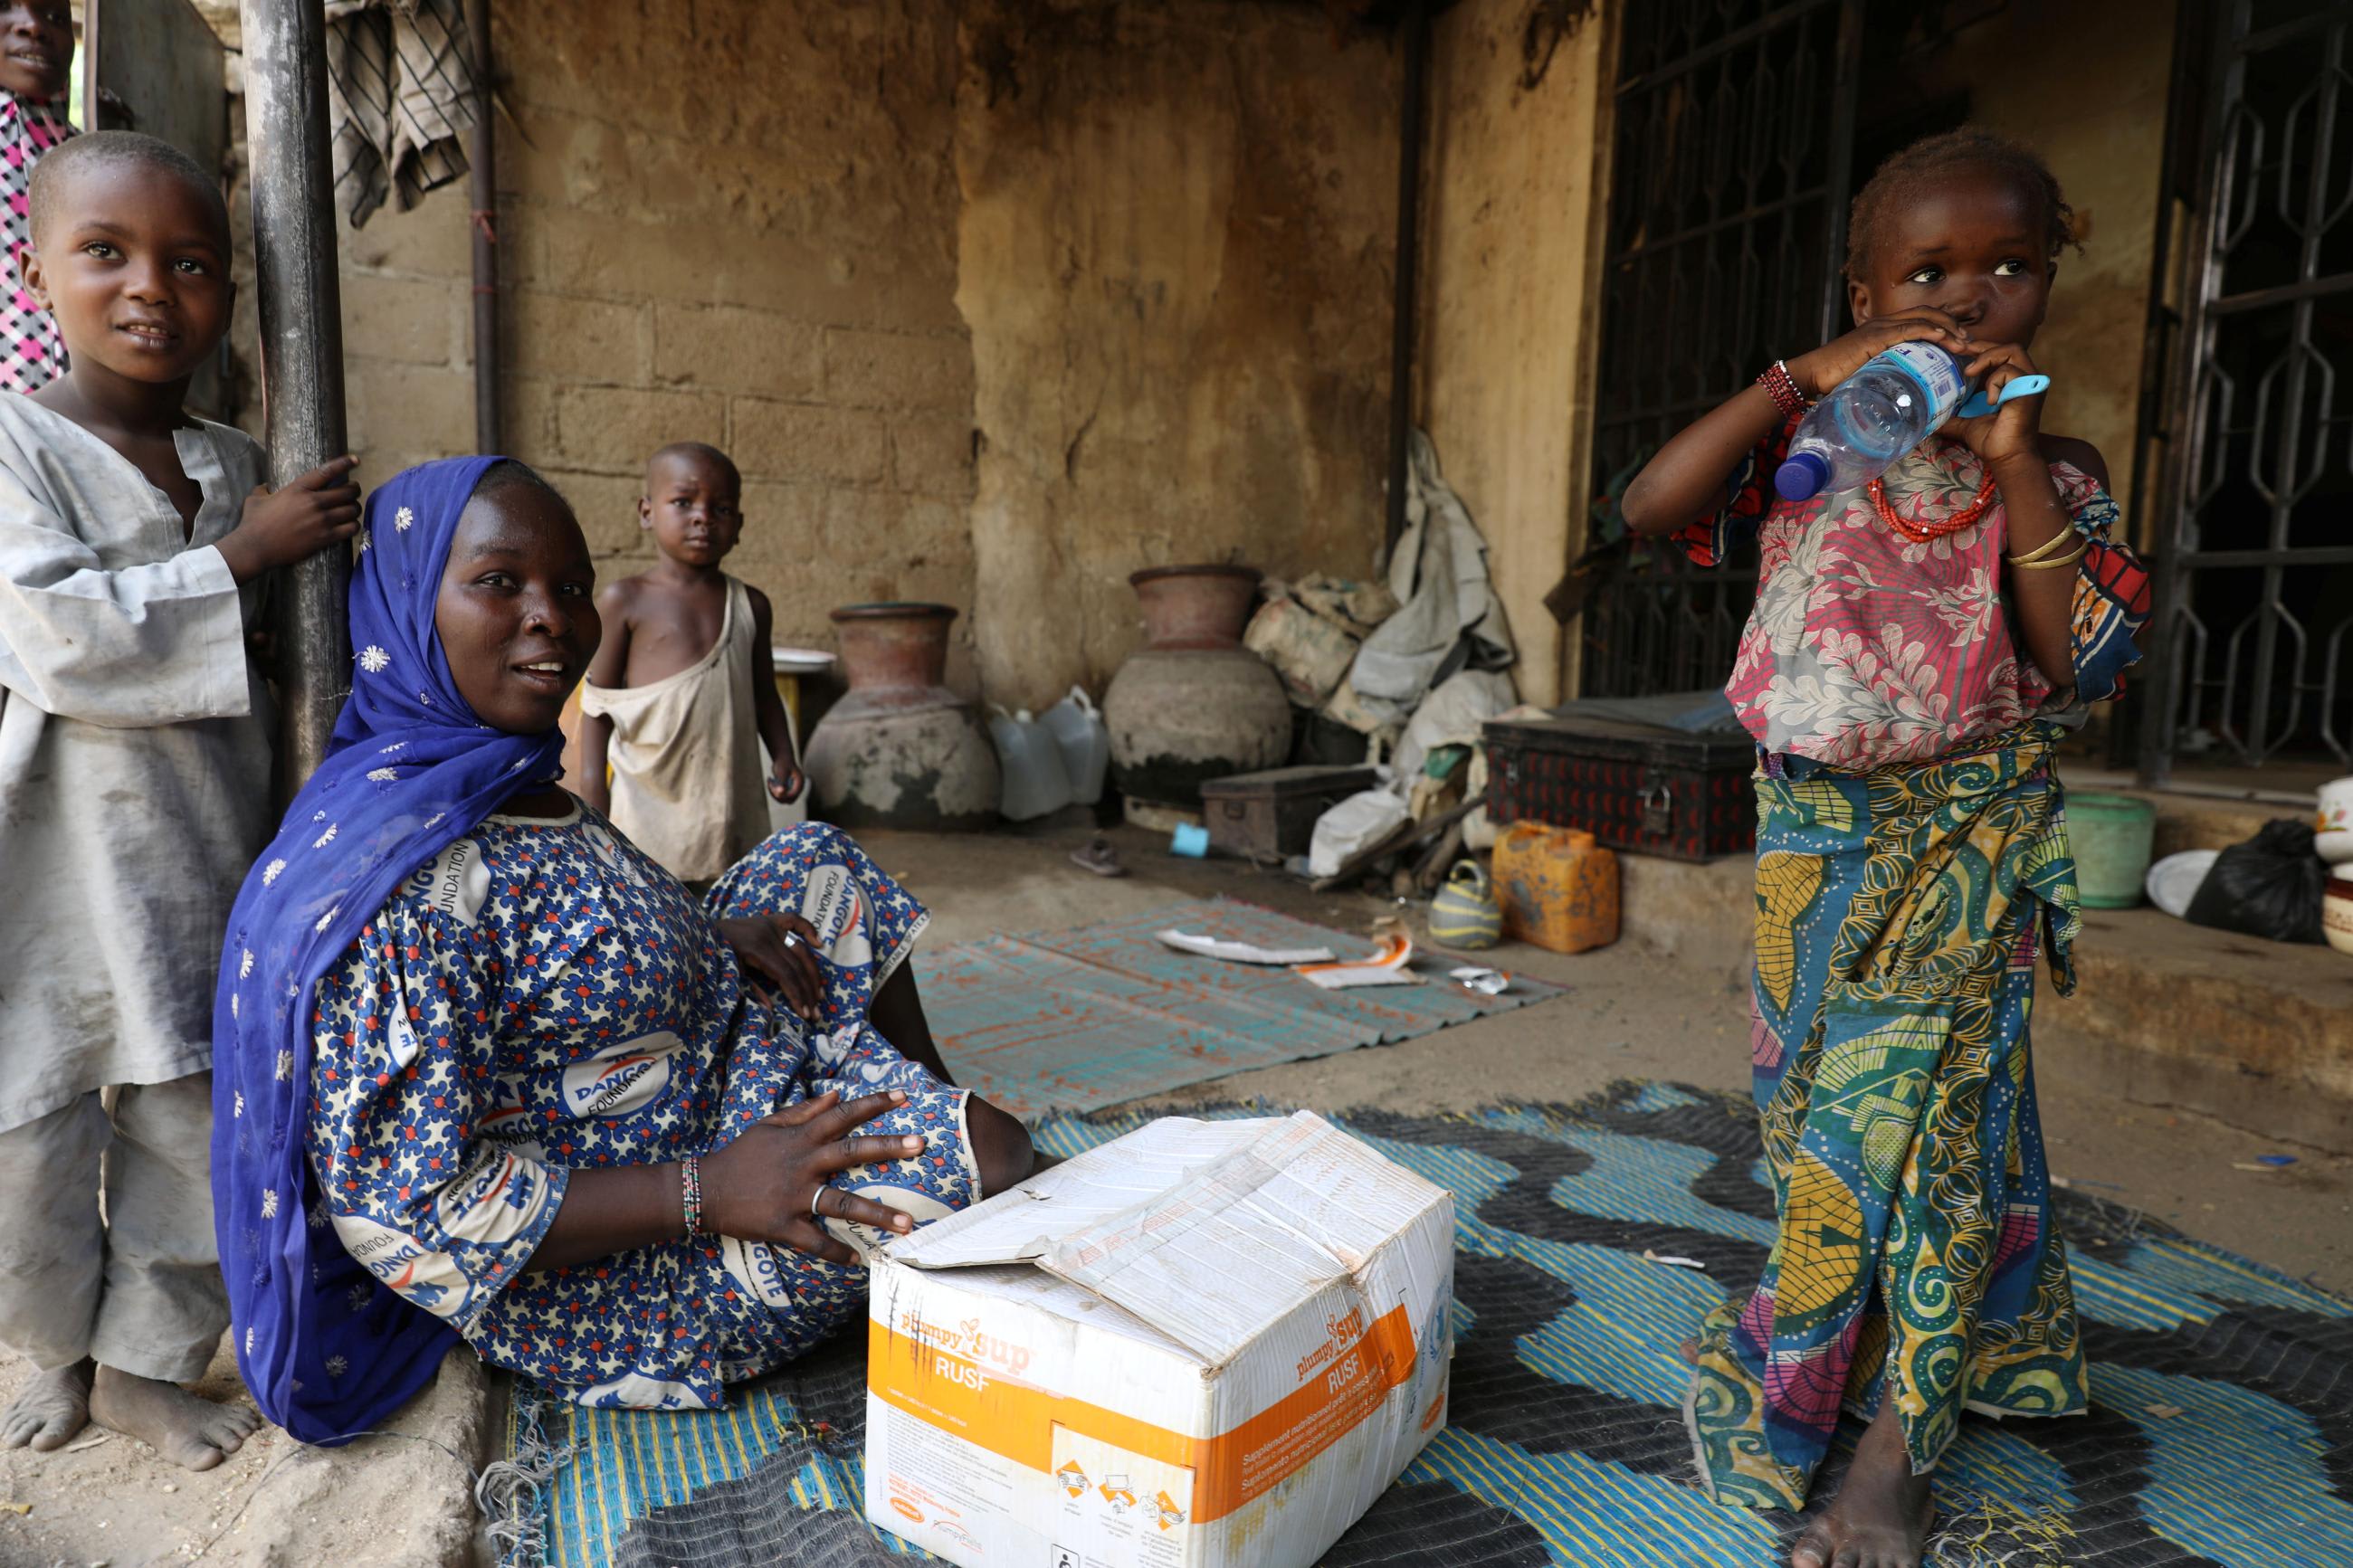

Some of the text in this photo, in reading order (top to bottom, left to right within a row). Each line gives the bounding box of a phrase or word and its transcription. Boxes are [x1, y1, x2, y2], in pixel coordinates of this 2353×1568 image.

[440, 841, 470, 914] UNDATION
[811, 870, 840, 930] FOUNDATIO
[348, 1232, 395, 1258] FOUNDA
[369, 1244, 423, 1278] DANG
[752, 1242, 786, 1298] GOTE
[935, 1355, 990, 1392] RUSF
[975, 1332, 1030, 1376] sup
[1296, 1339, 1334, 1383] plumpy
[1327, 1353, 1359, 1394] RUSF
